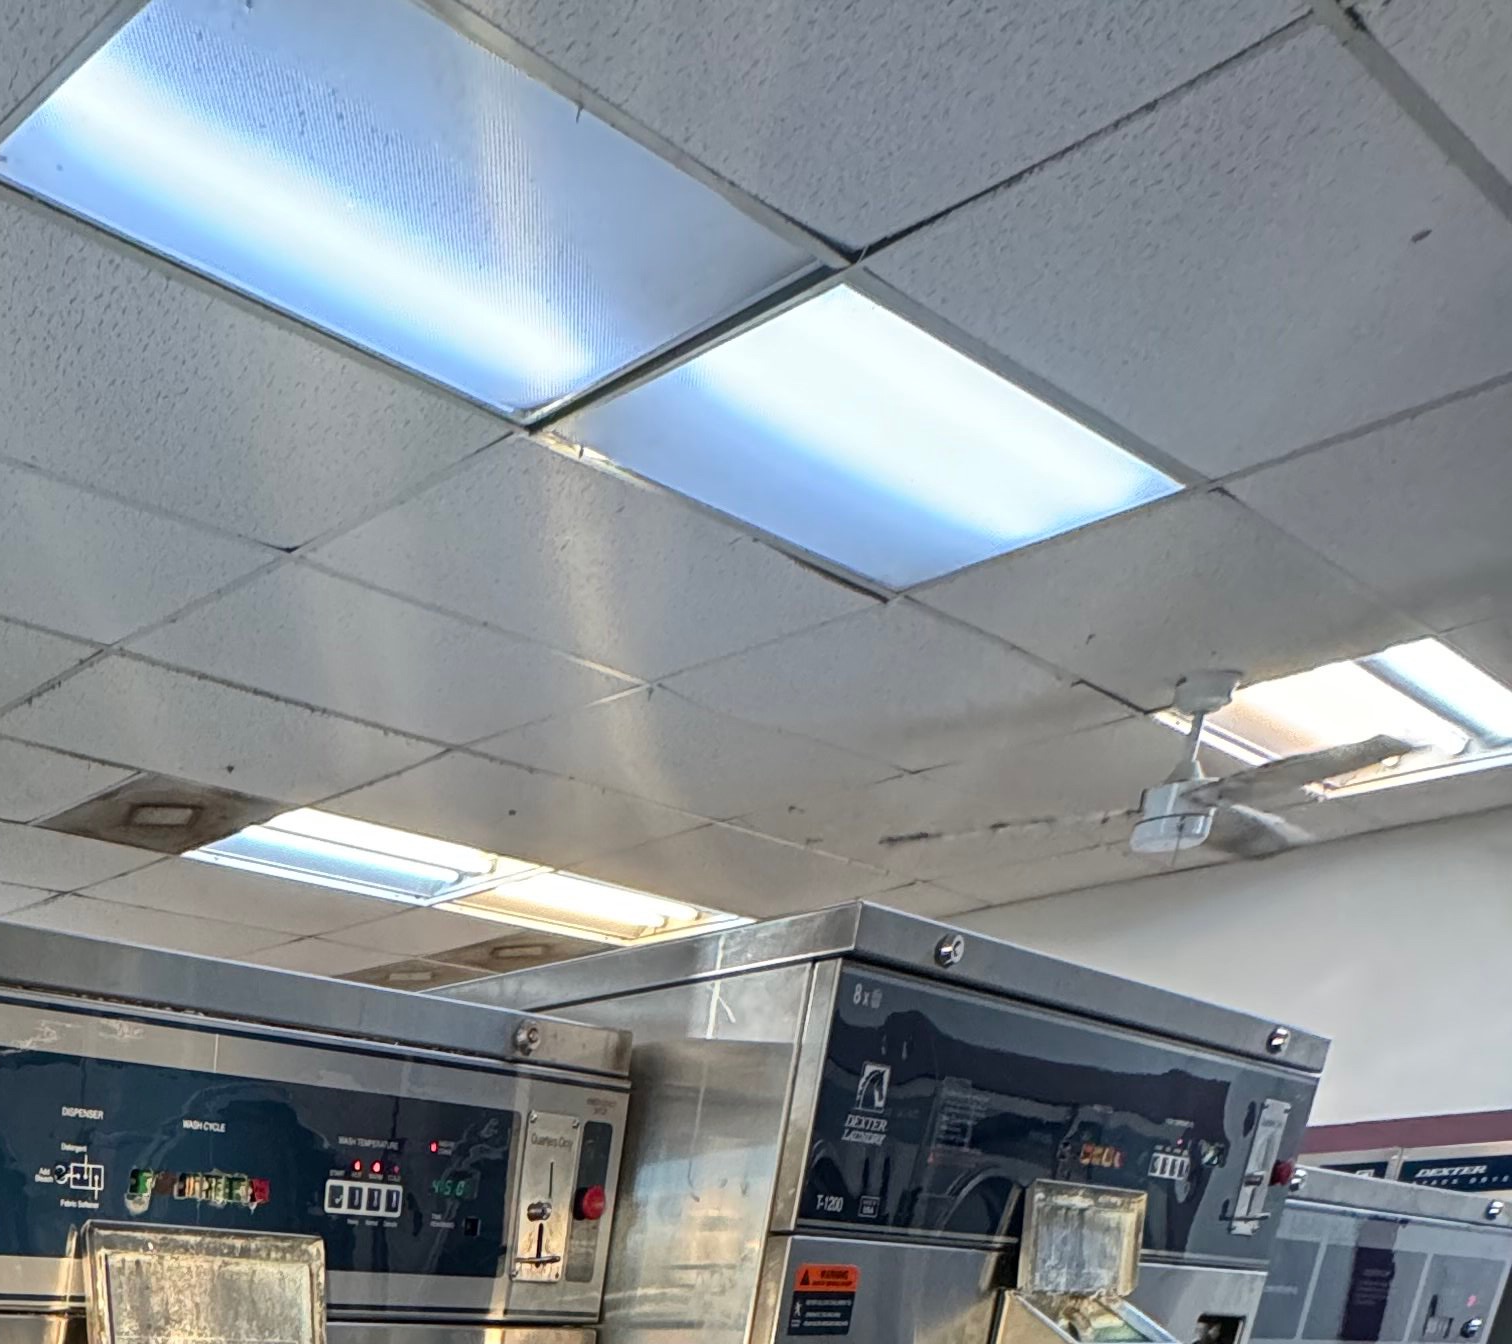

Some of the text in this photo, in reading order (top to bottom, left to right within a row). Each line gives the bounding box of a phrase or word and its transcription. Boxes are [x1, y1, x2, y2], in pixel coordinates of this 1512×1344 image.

[62, 1106, 104, 1120] DISPENSER
[203, 1121, 226, 1133] CYCLE
[845, 1114, 888, 1132] DEXTER
[1414, 1165, 1487, 1178] DEXTER
